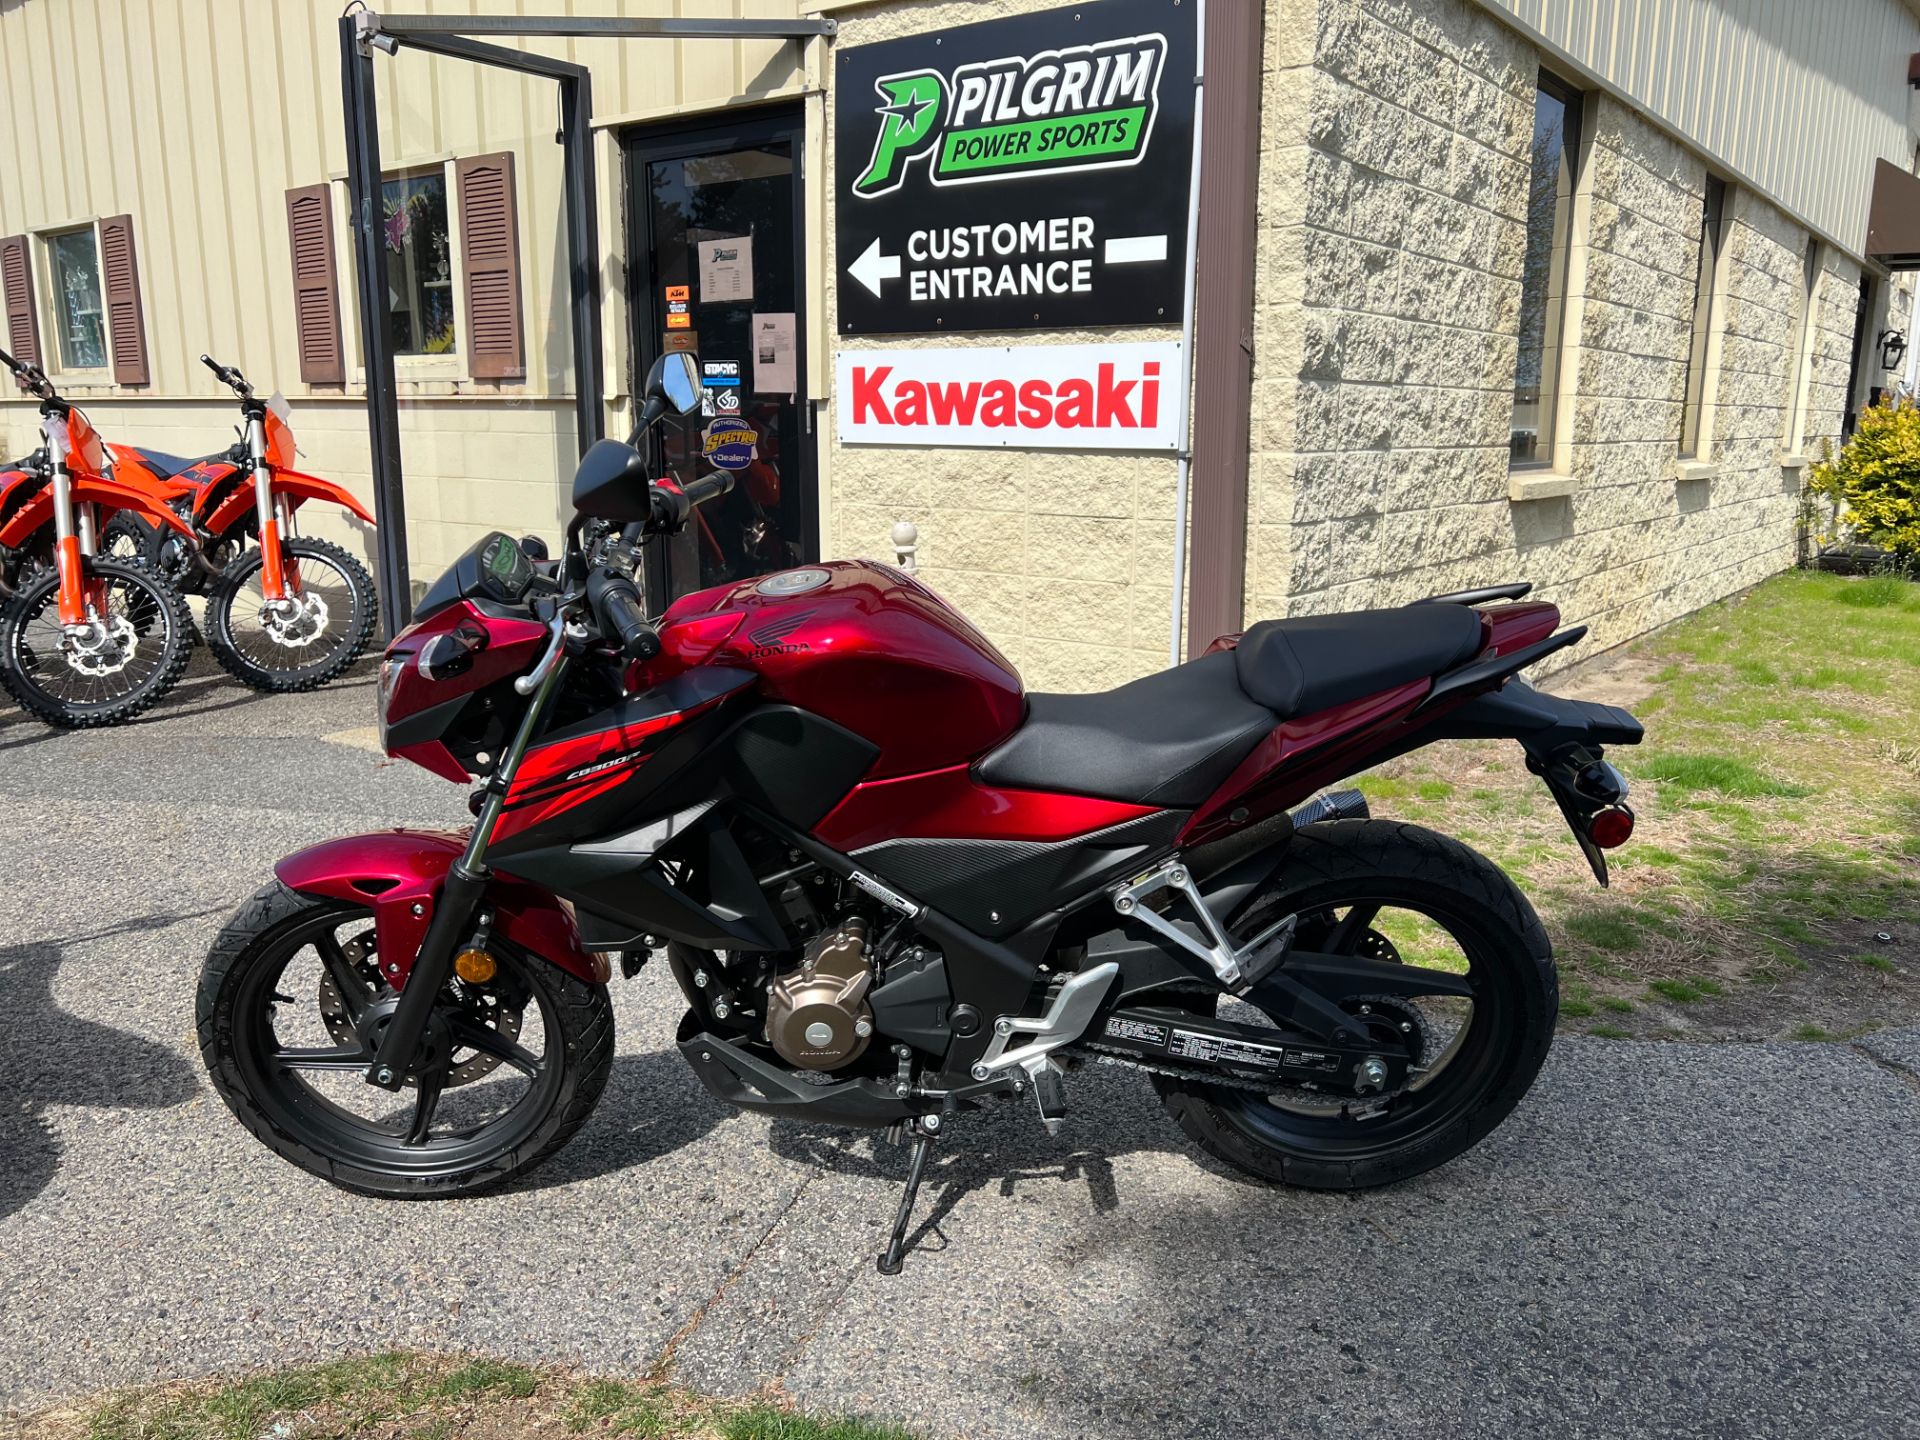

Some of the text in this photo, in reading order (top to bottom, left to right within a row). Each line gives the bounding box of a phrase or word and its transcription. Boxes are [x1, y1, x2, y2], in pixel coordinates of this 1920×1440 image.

[953, 49, 1156, 127] PILGRIM
[951, 117, 1130, 163] POWER SPORTS
[907, 216, 1095, 262] CUSTOMER
[909, 259, 1093, 301] ENTRANCE
[704, 363, 738, 376] STACYC
[851, 361, 1161, 429] Kawasaki
[704, 430, 758, 454] SPECTRO
[717, 454, 746, 462] Dealer
[748, 643, 810, 659] HONDA
